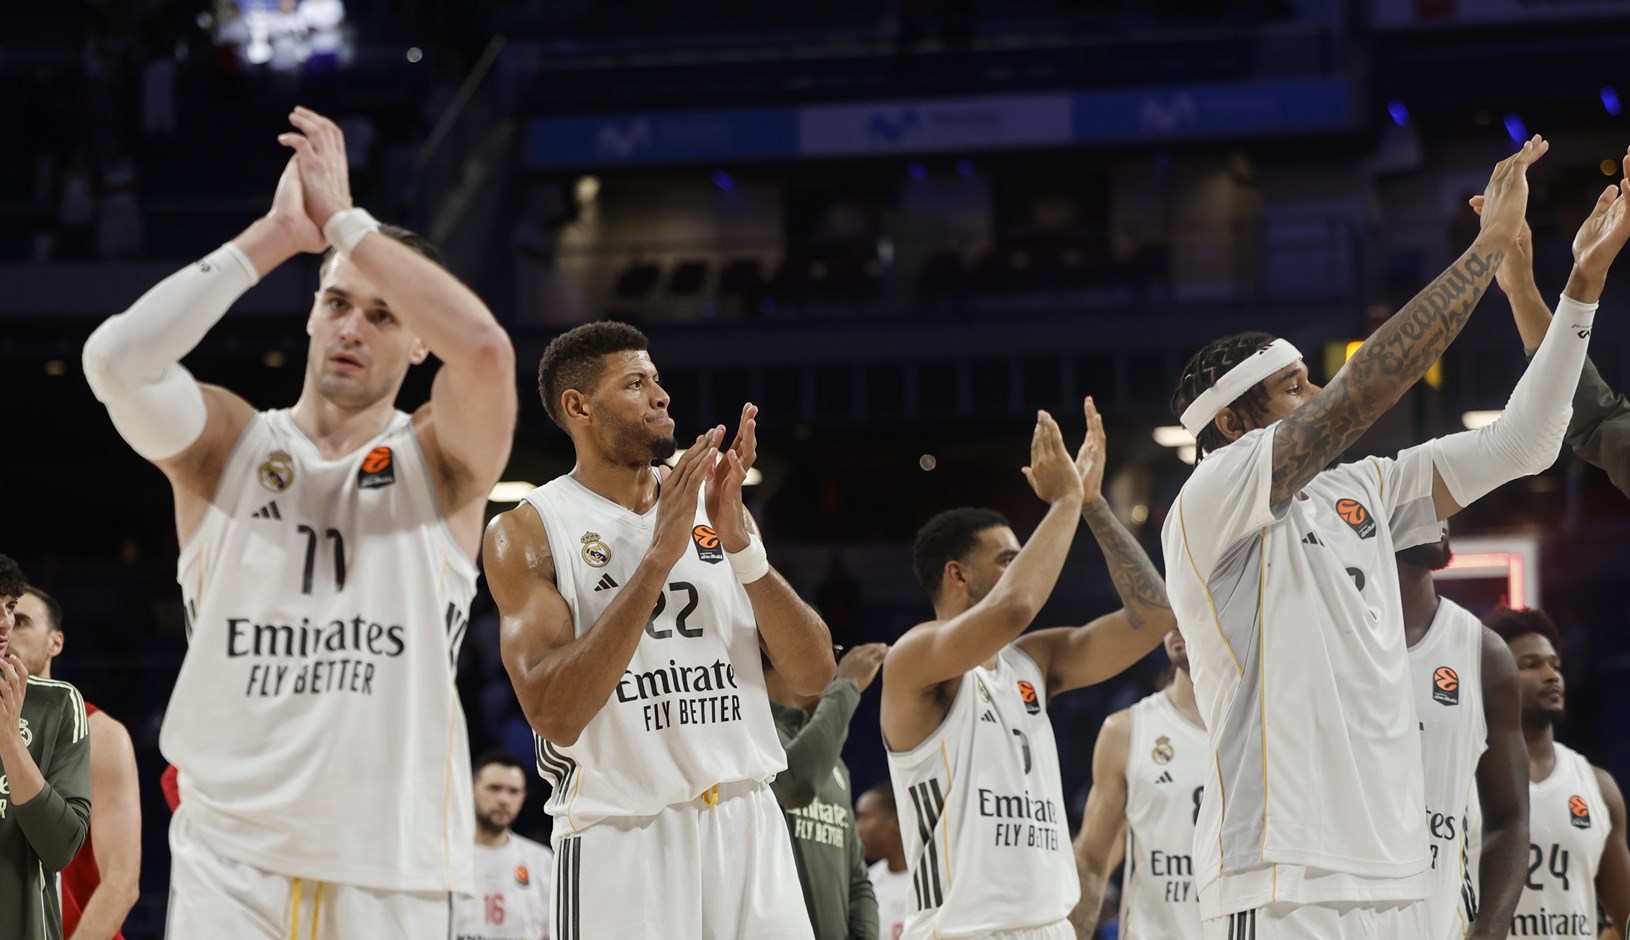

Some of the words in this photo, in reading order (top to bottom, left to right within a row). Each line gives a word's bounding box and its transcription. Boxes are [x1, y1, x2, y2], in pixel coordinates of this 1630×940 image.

[645, 581, 703, 639] 22
[226, 614, 405, 658] Emirates
[246, 665, 288, 697] FLY
[294, 660, 375, 695] BETTER
[616, 658, 738, 703] Emirate
[643, 700, 671, 732] FLY
[679, 695, 742, 725] BETTER
[995, 823, 1022, 847] FLY
[1524, 843, 1570, 892] 24
[483, 893, 506, 926] 16
[1165, 880, 1191, 903] FLY
[1508, 906, 1592, 937] mirate
